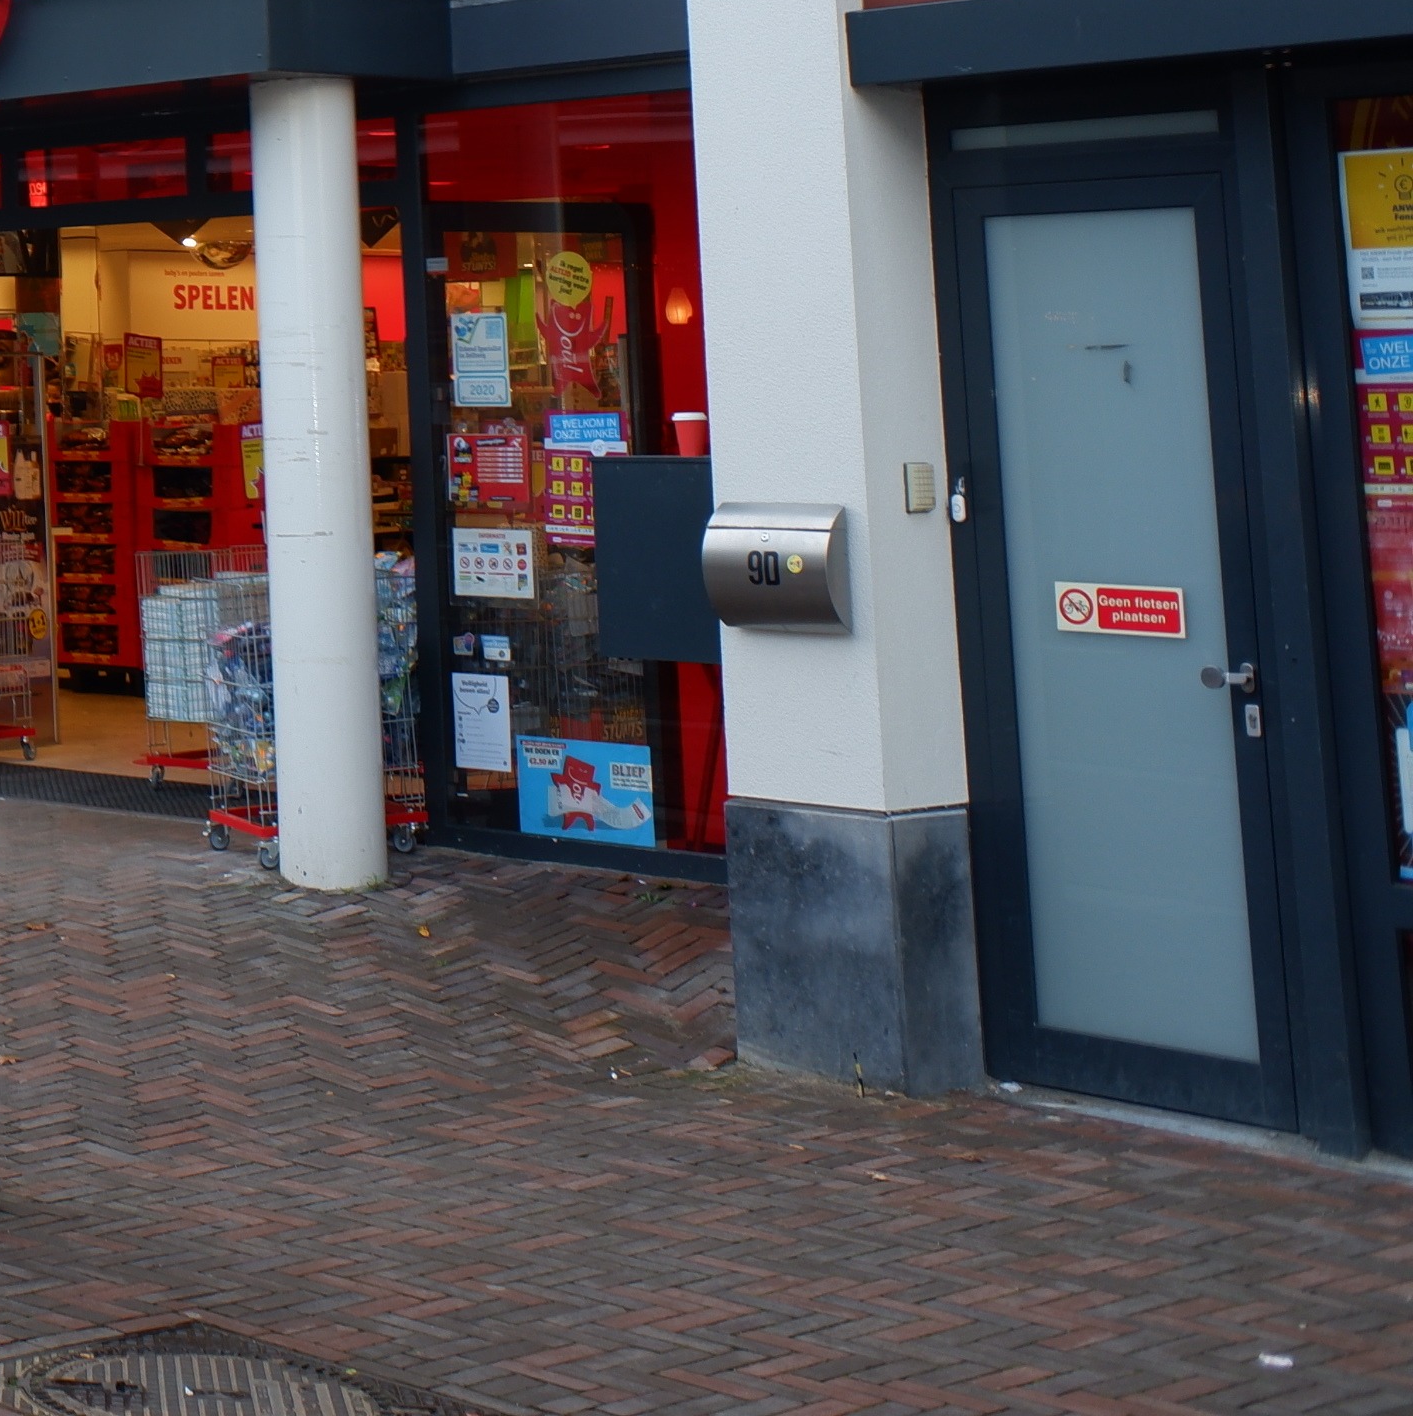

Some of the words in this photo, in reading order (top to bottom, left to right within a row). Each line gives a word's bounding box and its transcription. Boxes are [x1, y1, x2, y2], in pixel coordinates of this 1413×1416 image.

[174, 284, 255, 311] SPELEN
[127, 336, 157, 349] ACTIE!
[1368, 355, 1411, 371] ONZE
[469, 384, 495, 396] 2020
[562, 418, 605, 428] WELKOM
[606, 417, 617, 427] IN
[554, 430, 582, 440] ONZE
[583, 428, 620, 439] WINKEL
[1098, 594, 1131, 608] Geen
[1134, 596, 1179, 611] fietsen
[1112, 610, 1166, 624] plaatsen
[611, 764, 646, 779] BLIEP
